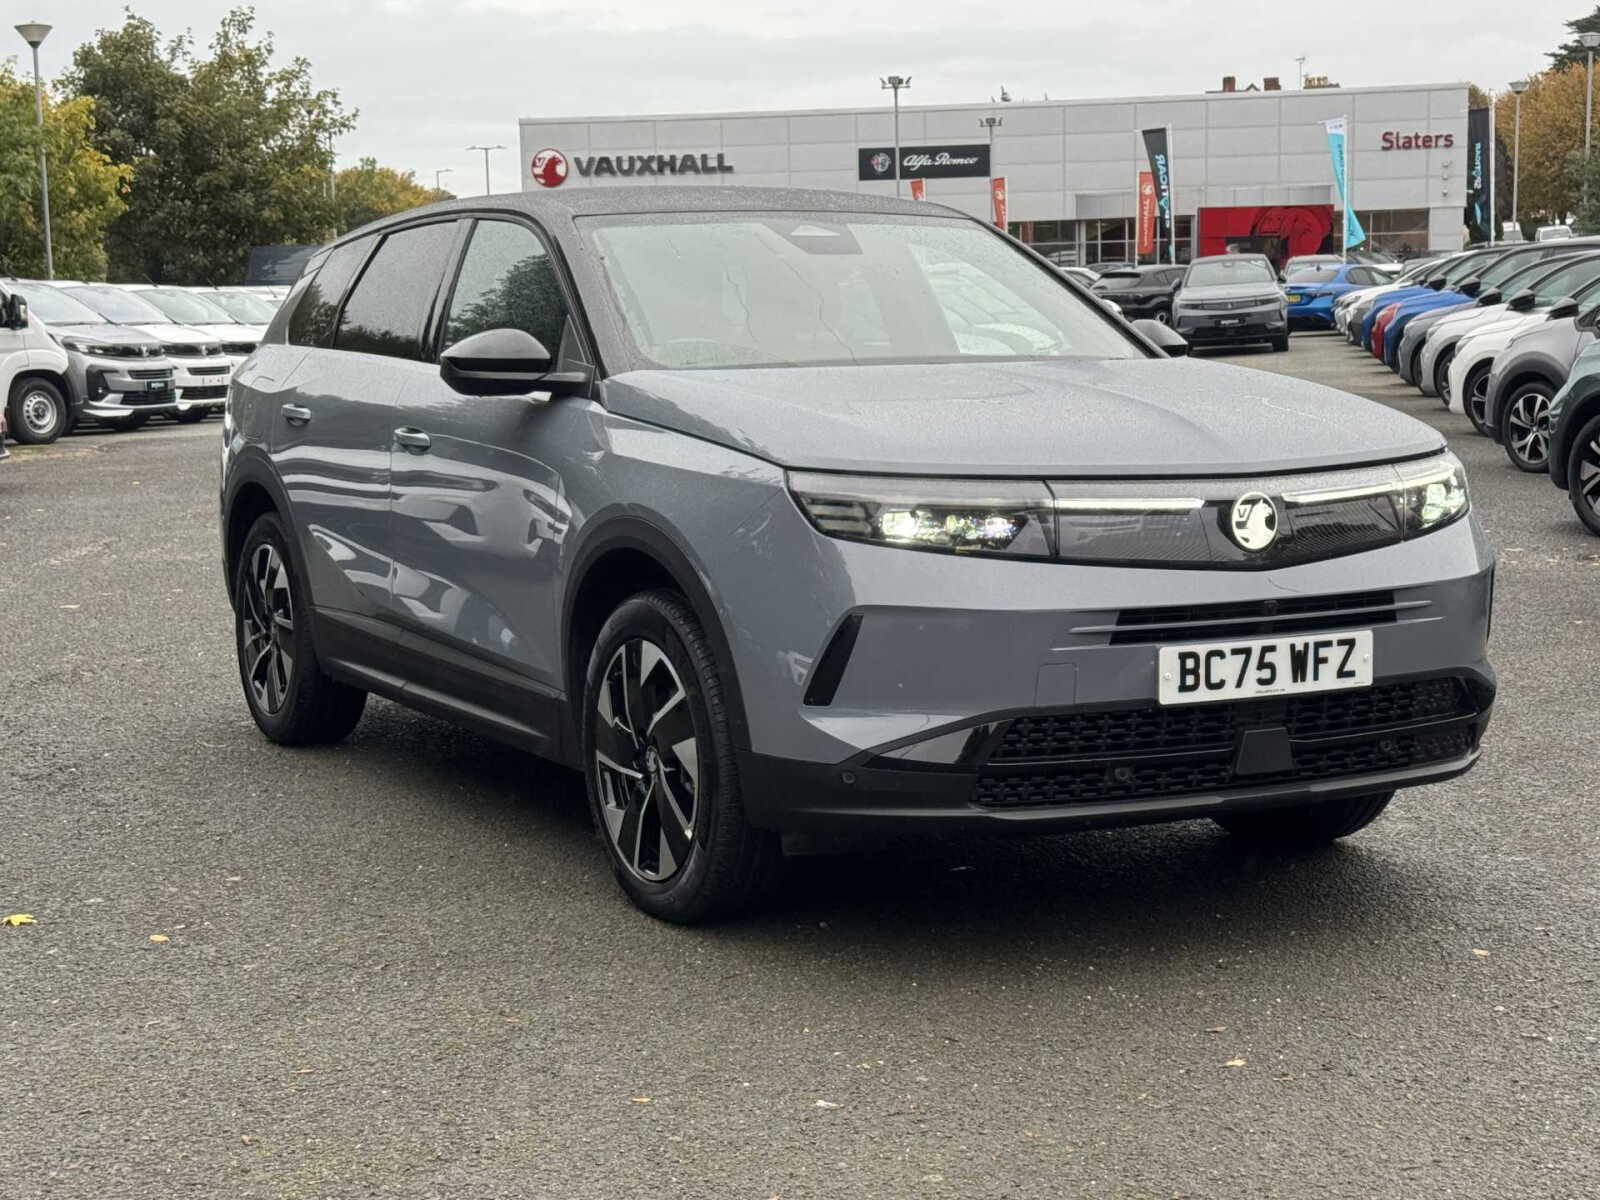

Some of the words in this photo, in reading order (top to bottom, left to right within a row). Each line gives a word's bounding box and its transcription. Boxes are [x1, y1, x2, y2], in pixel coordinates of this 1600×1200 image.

[1381, 131, 1454, 151] Slaters
[574, 153, 734, 177] VAUXHALL
[903, 154, 932, 171] Alfa
[934, 152, 979, 166] Romeo
[1178, 645, 1277, 693] BC75
[1290, 638, 1356, 683] WFZ
